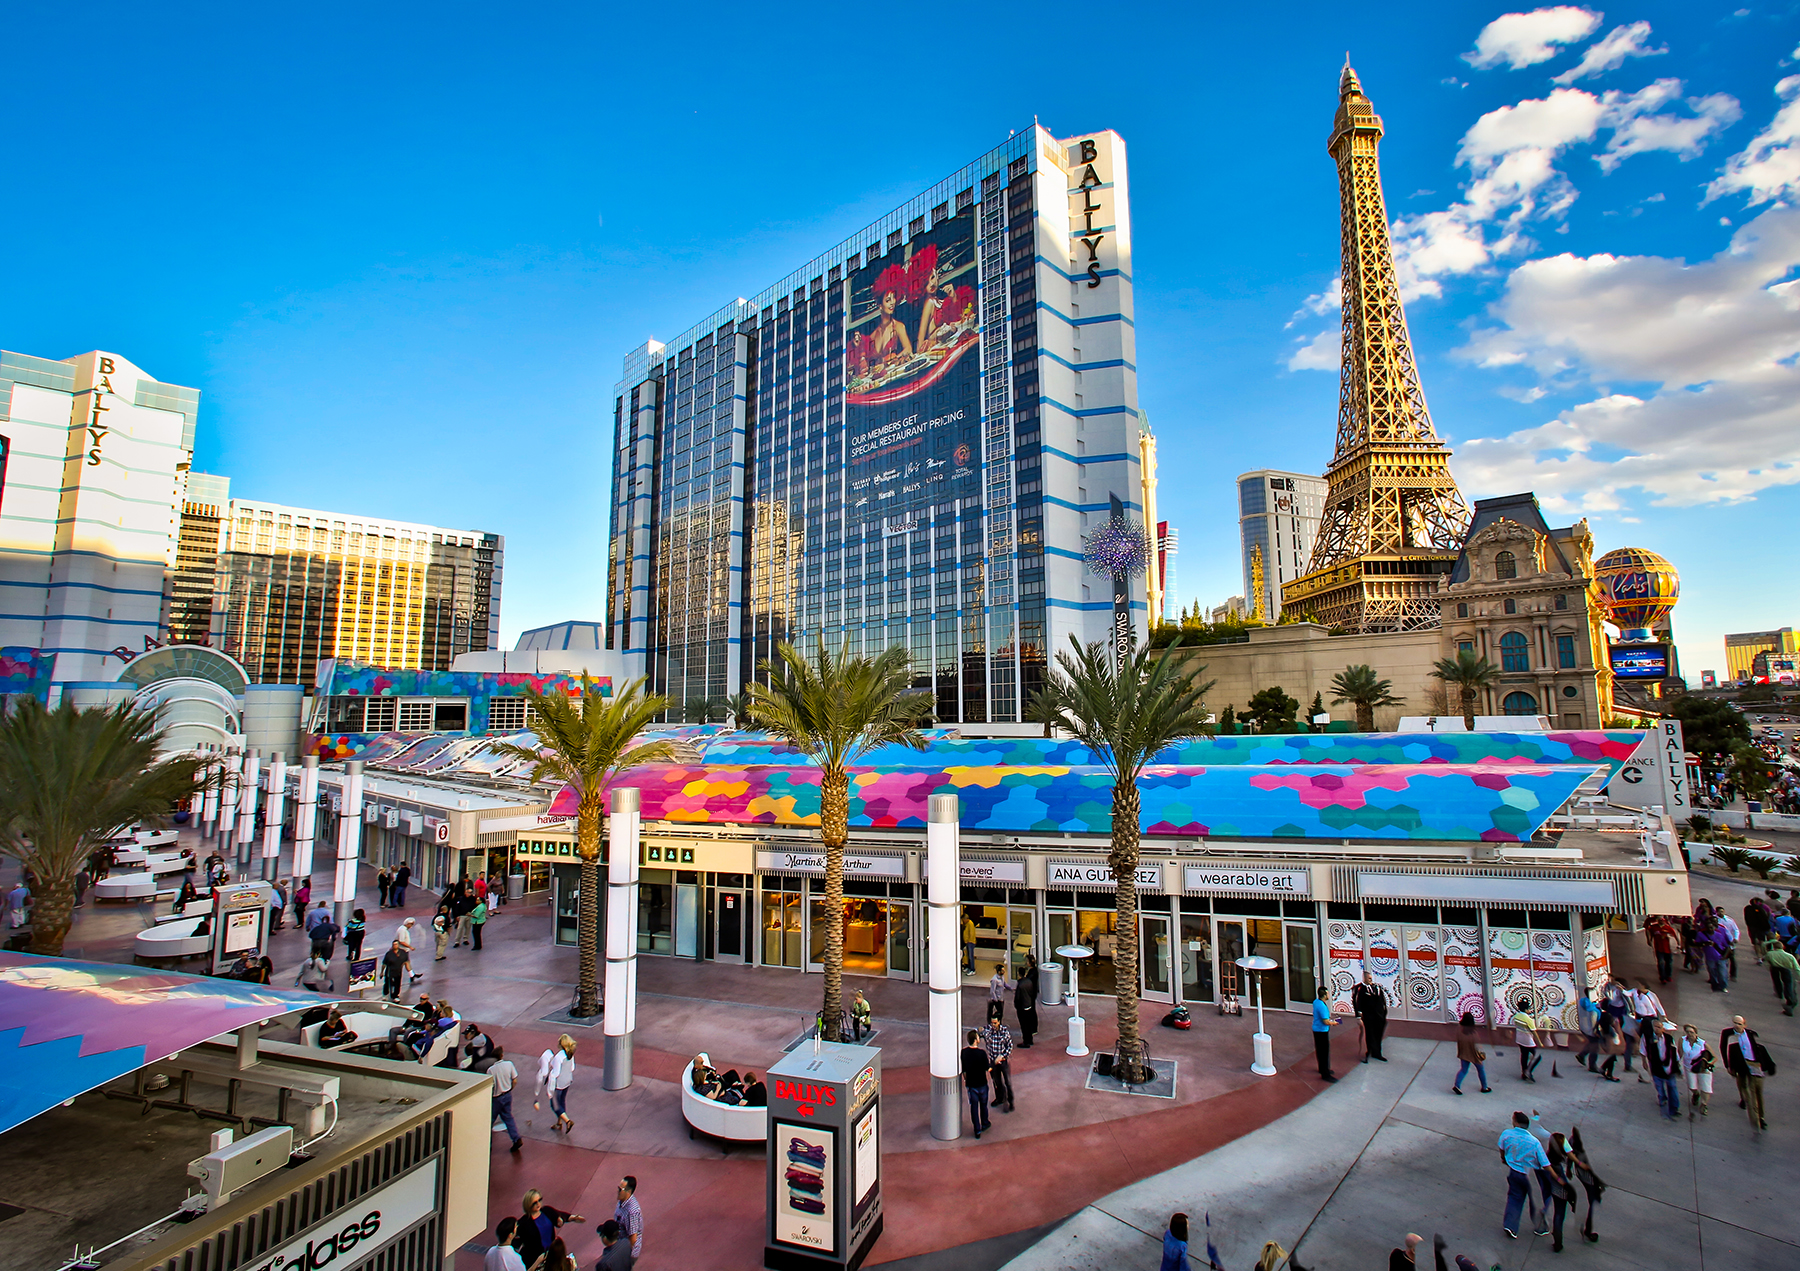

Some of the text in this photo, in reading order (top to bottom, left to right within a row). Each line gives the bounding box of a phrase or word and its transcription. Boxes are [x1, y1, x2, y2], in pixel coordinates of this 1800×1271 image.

[1078, 139, 1104, 288] BALLYS
[87, 357, 115, 466] BALLYS
[851, 414, 918, 446] OUR MEMBERS GET
[851, 409, 966, 458] SPECIAL RESTAURANT PRICING.
[1611, 568, 1648, 604] Paris
[1664, 723, 1684, 806] BALLYS
[1054, 868, 1082, 881] ANA
[1200, 873, 1293, 887] wearable art
[791, 1232, 823, 1245] SWAROVSKI
